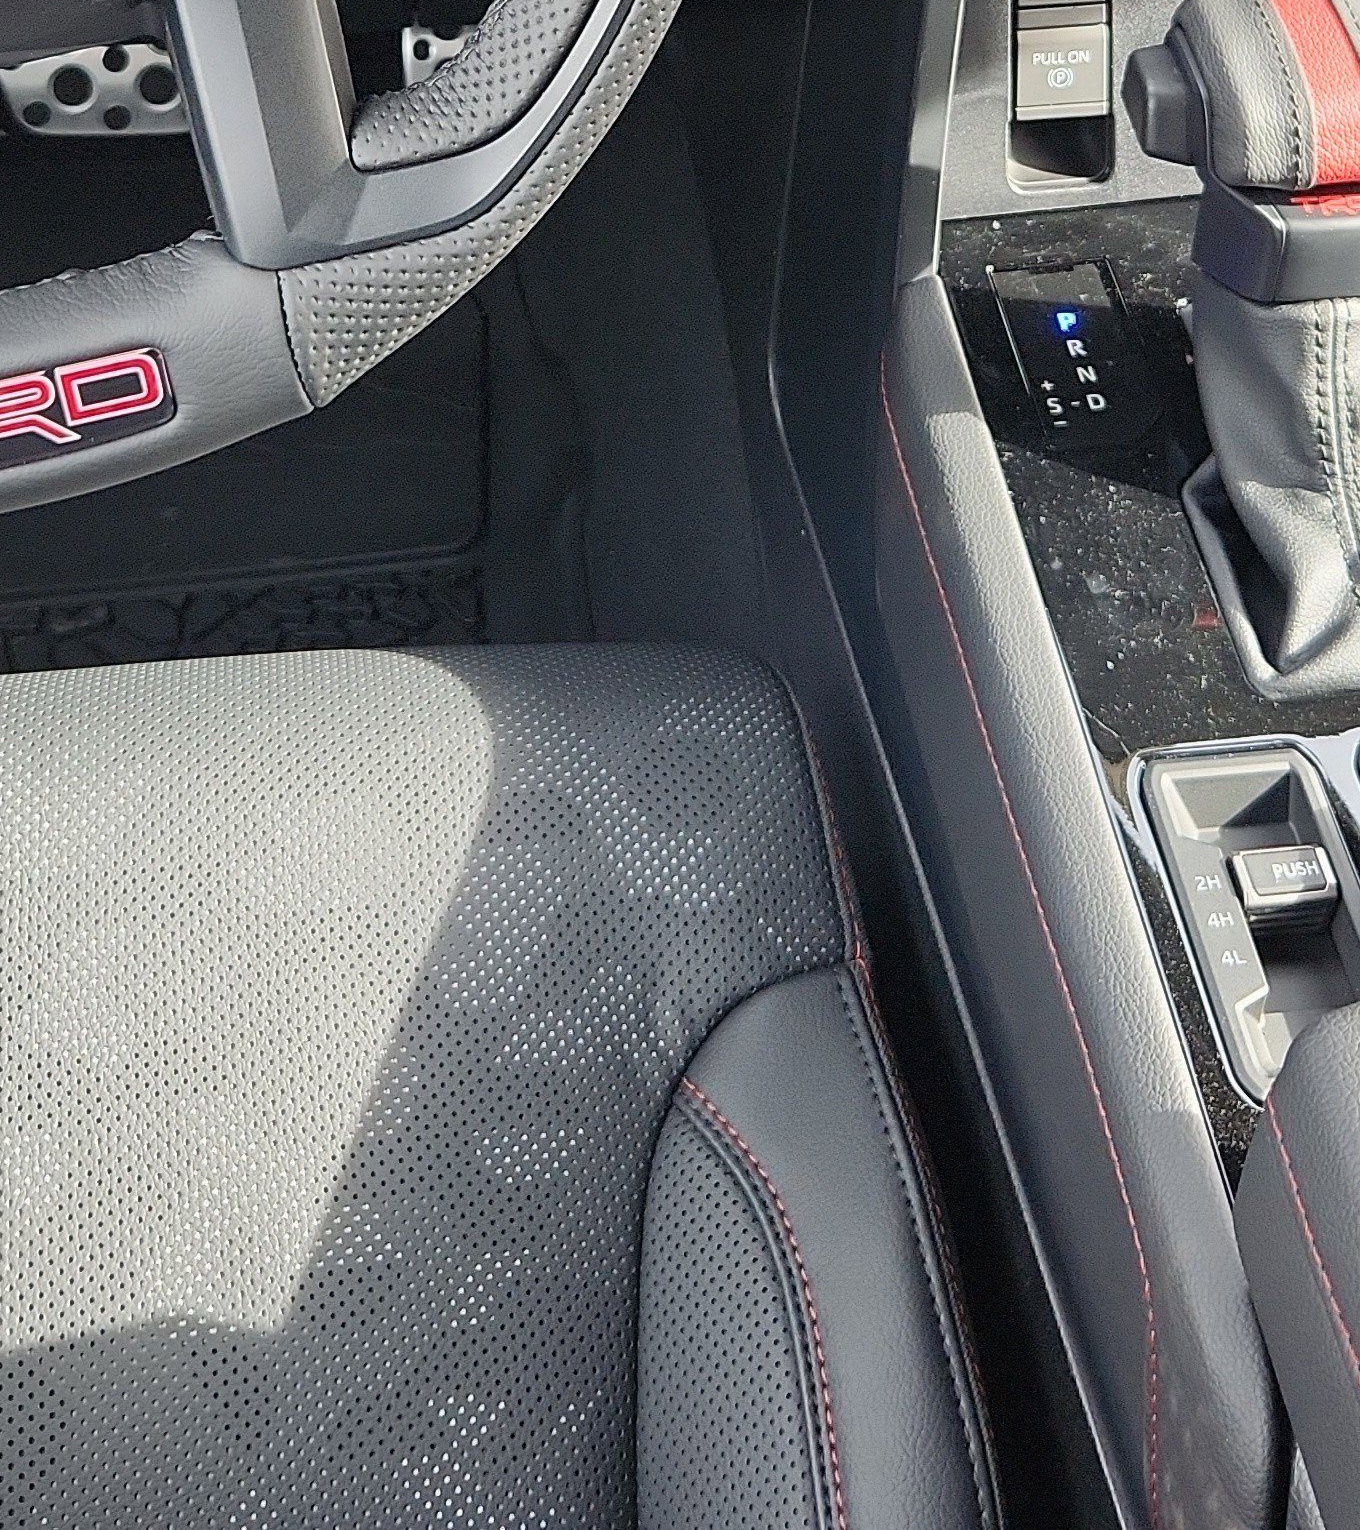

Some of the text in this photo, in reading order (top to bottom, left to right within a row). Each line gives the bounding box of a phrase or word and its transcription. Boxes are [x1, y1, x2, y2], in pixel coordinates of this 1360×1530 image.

[1032, 50, 1091, 66] PULL ON
[1055, 311, 1078, 334] P
[1065, 338, 1089, 359] R
[1075, 364, 1098, 385] N
[1046, 391, 1107, 416] S D
[1272, 858, 1321, 883] PUSH
[1194, 871, 1222, 892] 2H
[1206, 909, 1234, 930] 4H
[1220, 947, 1248, 967] 4L
